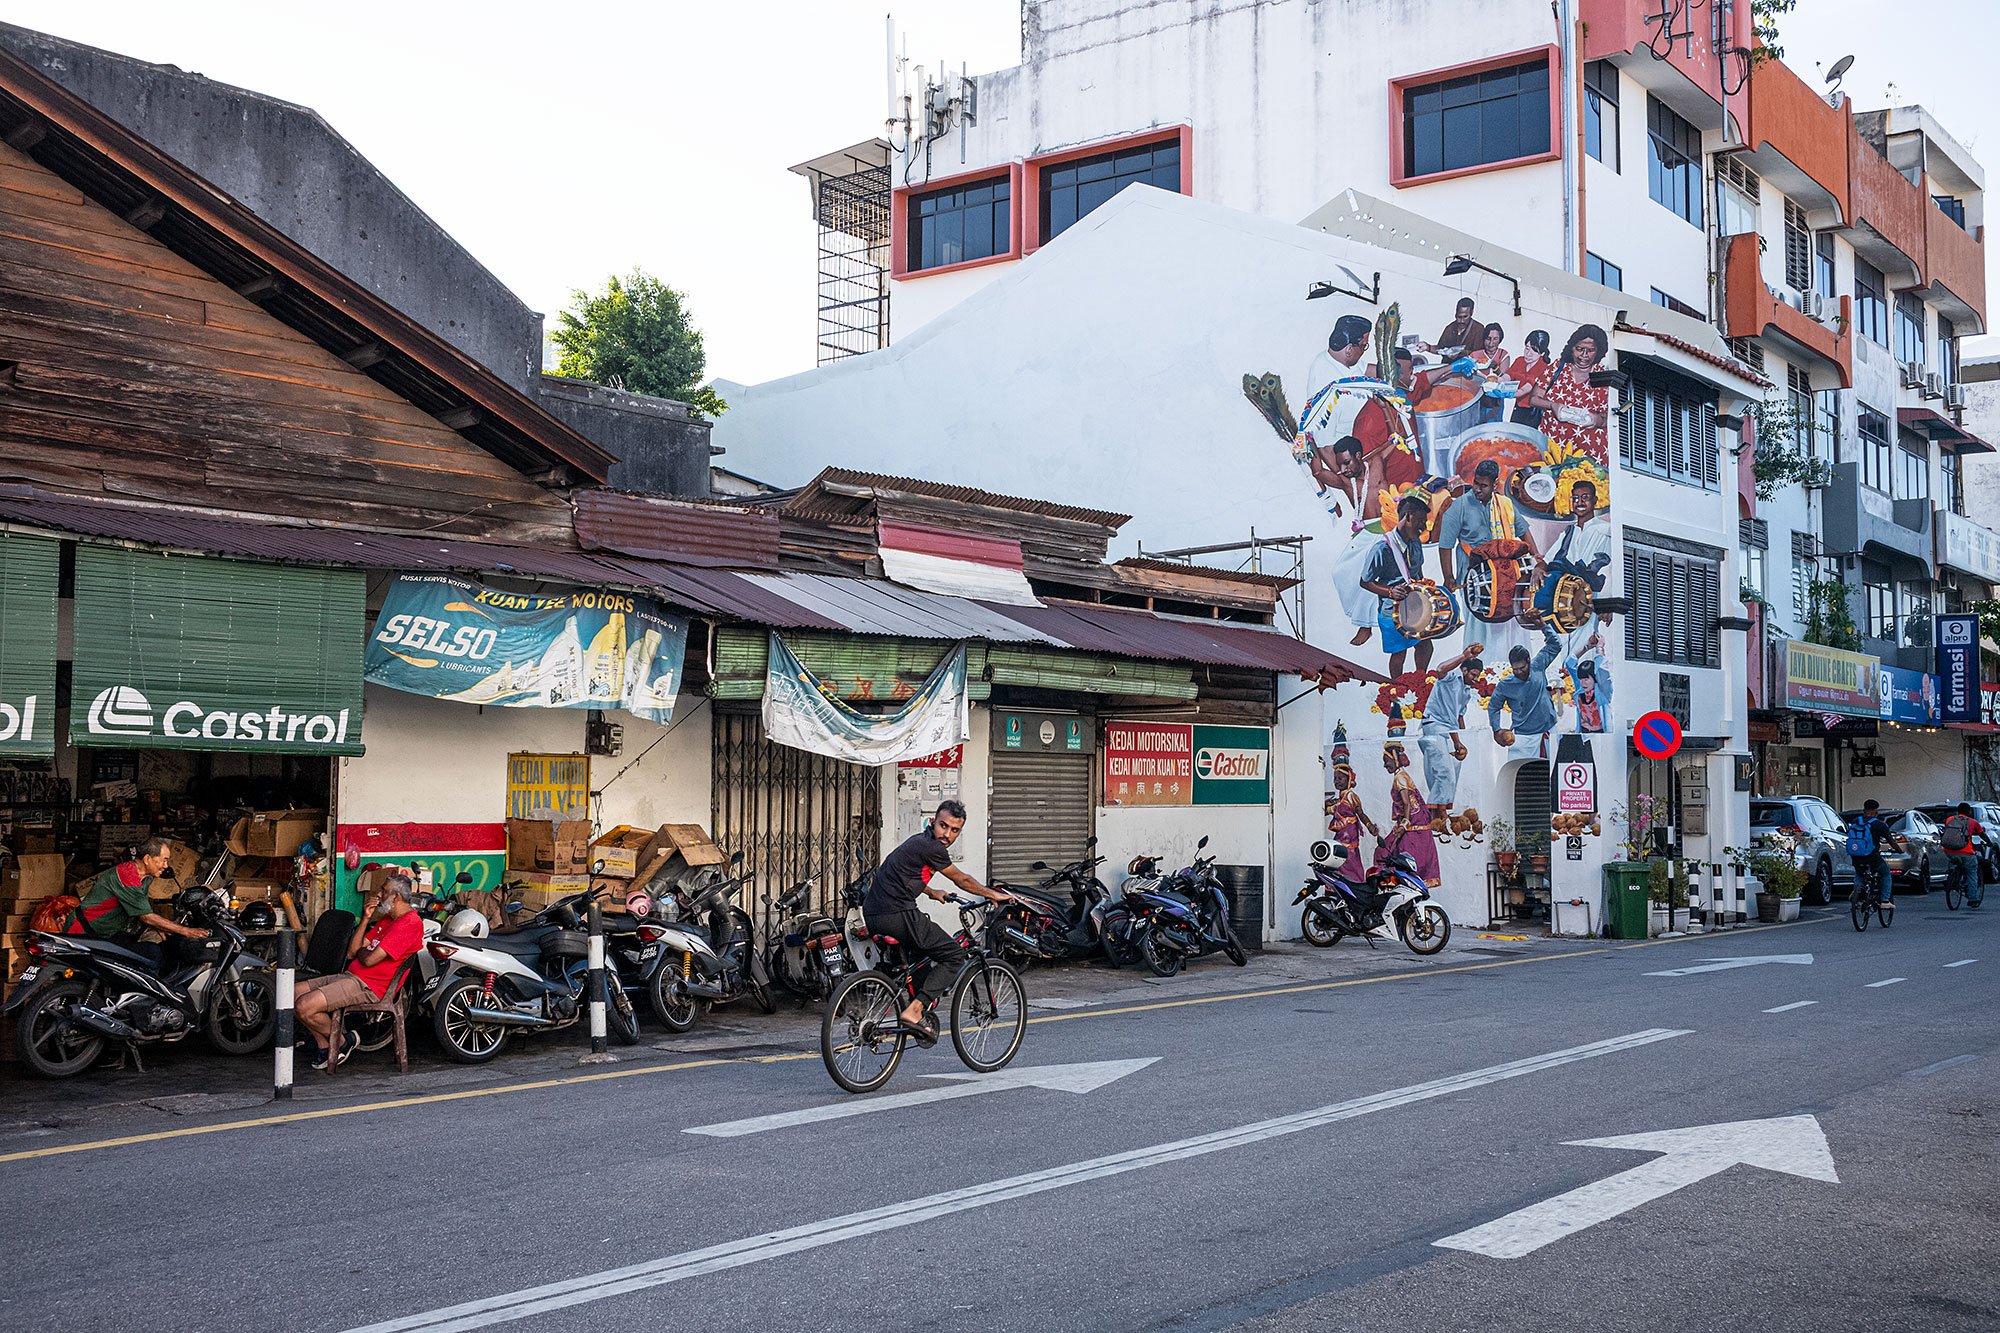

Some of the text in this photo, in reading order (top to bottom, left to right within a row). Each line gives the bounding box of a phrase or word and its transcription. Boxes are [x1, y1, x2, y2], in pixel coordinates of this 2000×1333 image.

[400, 574, 423, 582] PUSAT
[423, 576, 447, 584] SERVIS
[474, 590, 635, 613] KUAN YEE MOTORS
[376, 614, 497, 660] SELSO
[1944, 634, 1969, 643] alpro
[440, 660, 492, 674] LUBRICANTS
[1807, 654, 1831, 683] DIVINE
[1832, 658, 1857, 687] CRAFTS
[1947, 648, 1965, 713] farmasi
[163, 701, 349, 744] Castrol
[1110, 730, 1189, 752] KEDAI MOTORSIKAL
[512, 760, 585, 785] KEDAI MOTOR
[1109, 757, 1190, 777] KEDAI MOTOR KUAN YEE
[1214, 752, 1260, 777] Castrol
[1741, 762, 1751, 779] 19
[823, 946, 838, 955] PAR
